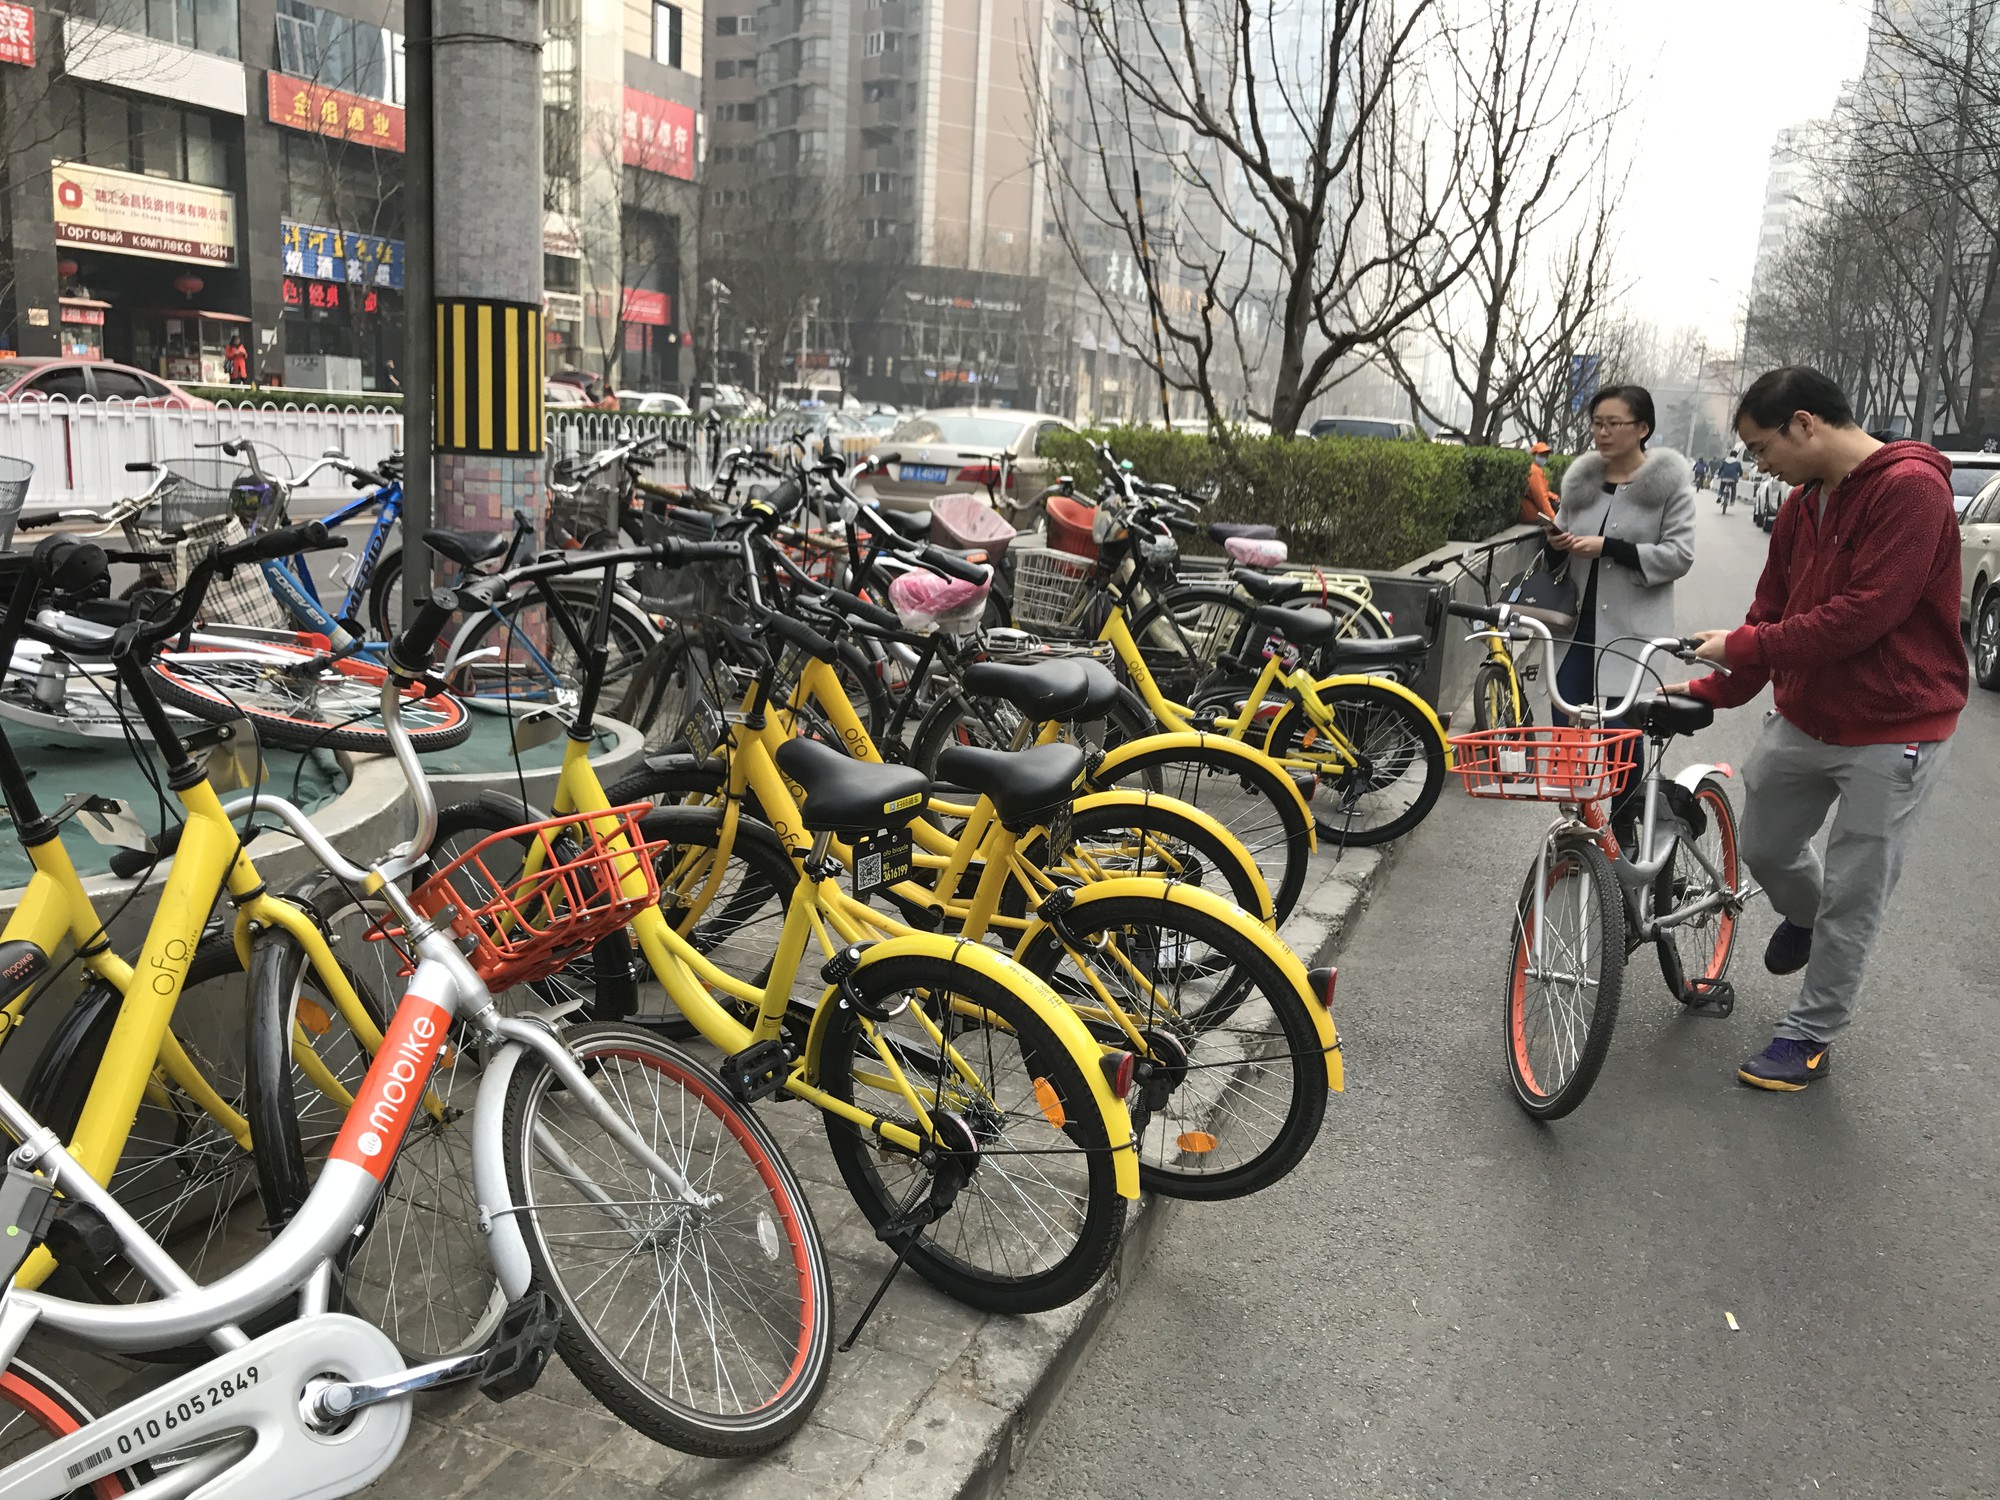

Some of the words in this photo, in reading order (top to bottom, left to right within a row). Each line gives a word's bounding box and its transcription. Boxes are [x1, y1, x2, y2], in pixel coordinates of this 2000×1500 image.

[58, 222, 124, 245] Торговый
[345, 523, 392, 620] MERIDA
[267, 566, 328, 626] FOREVER
[1129, 659, 1146, 684] ofo
[844, 727, 868, 758] ofo
[882, 863, 909, 882] 3616199
[2, 952, 35, 979] mobike
[150, 938, 188, 996] ofo
[368, 1016, 436, 1134] mobike
